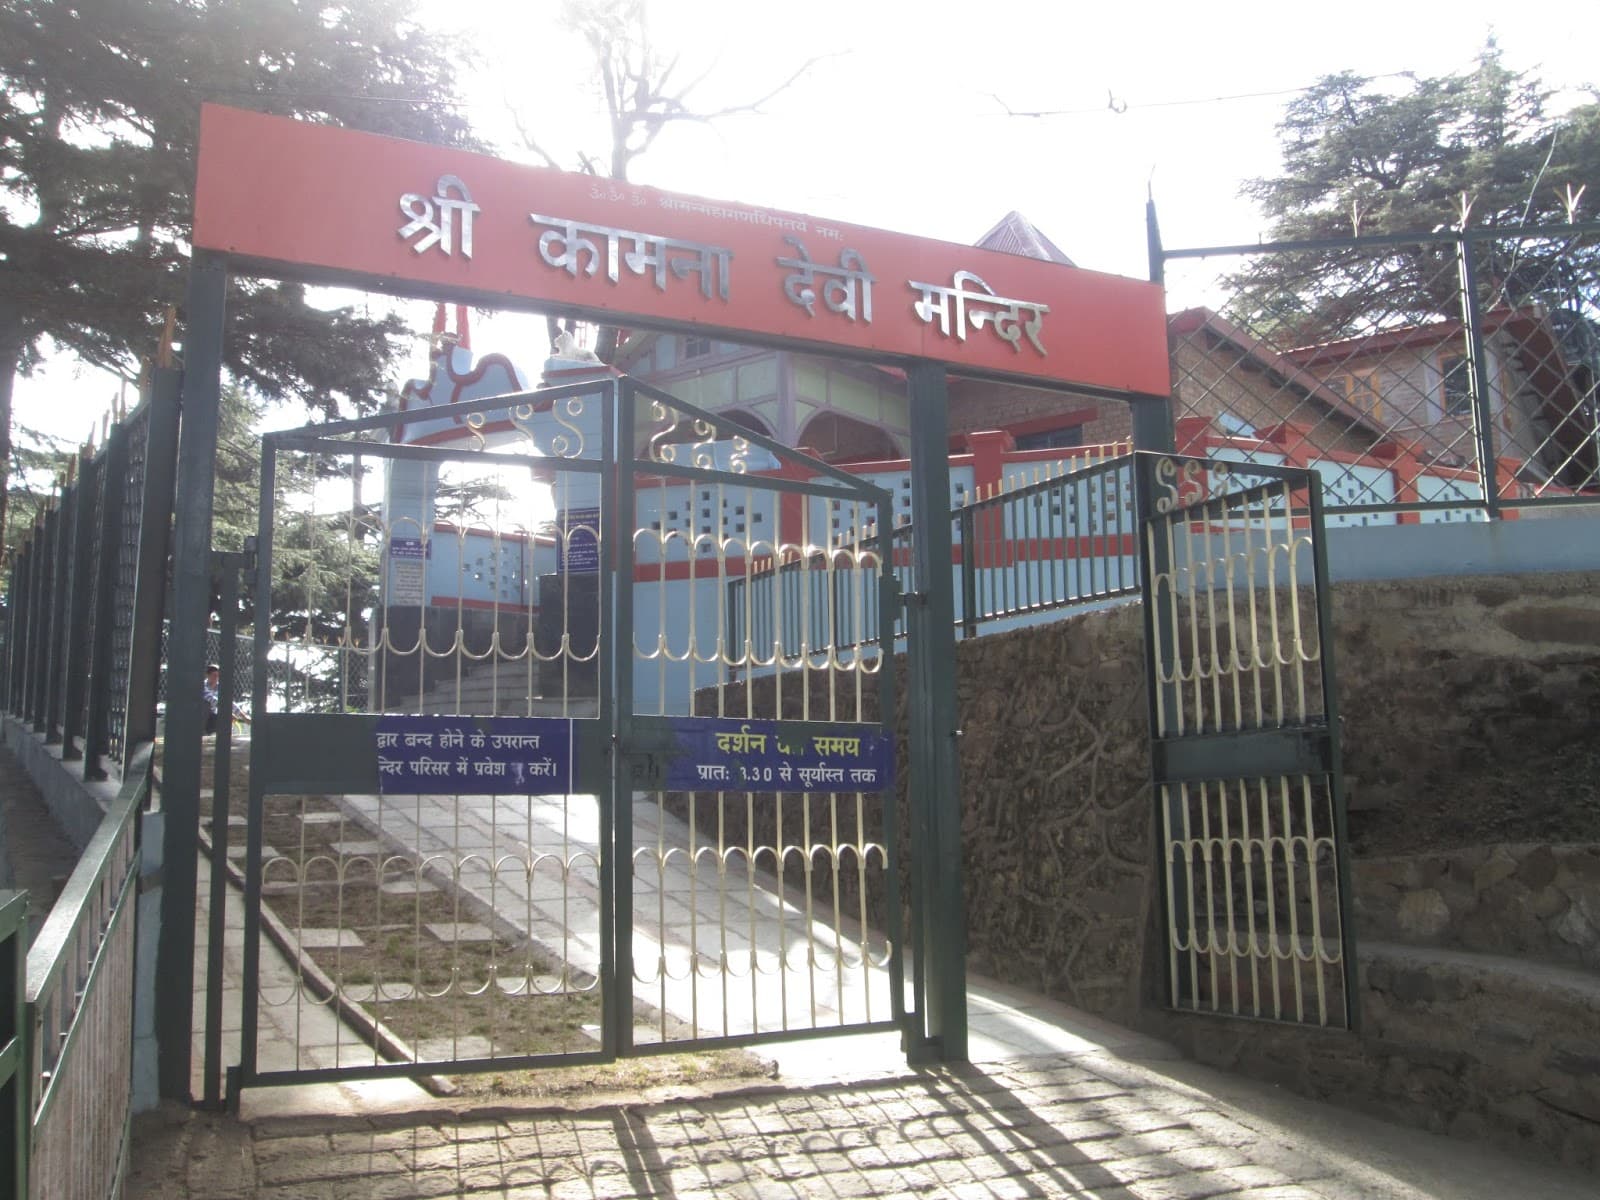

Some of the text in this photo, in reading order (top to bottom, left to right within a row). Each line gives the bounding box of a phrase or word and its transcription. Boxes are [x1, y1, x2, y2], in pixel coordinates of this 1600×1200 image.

[397, 174, 1051, 357] श्री कामना देवी मन्दिर
[376, 728, 541, 750] द्वार बन्द होने के उपरान्त
[715, 724, 767, 755] दर्शन
[812, 735, 861, 758] समय
[409, 756, 450, 776] परिसर
[455, 756, 470, 776] में
[473, 756, 507, 776] प्रवेश
[778, 761, 793, 783] से
[797, 761, 845, 788] सूर्यास्त
[848, 768, 878, 784] तक
